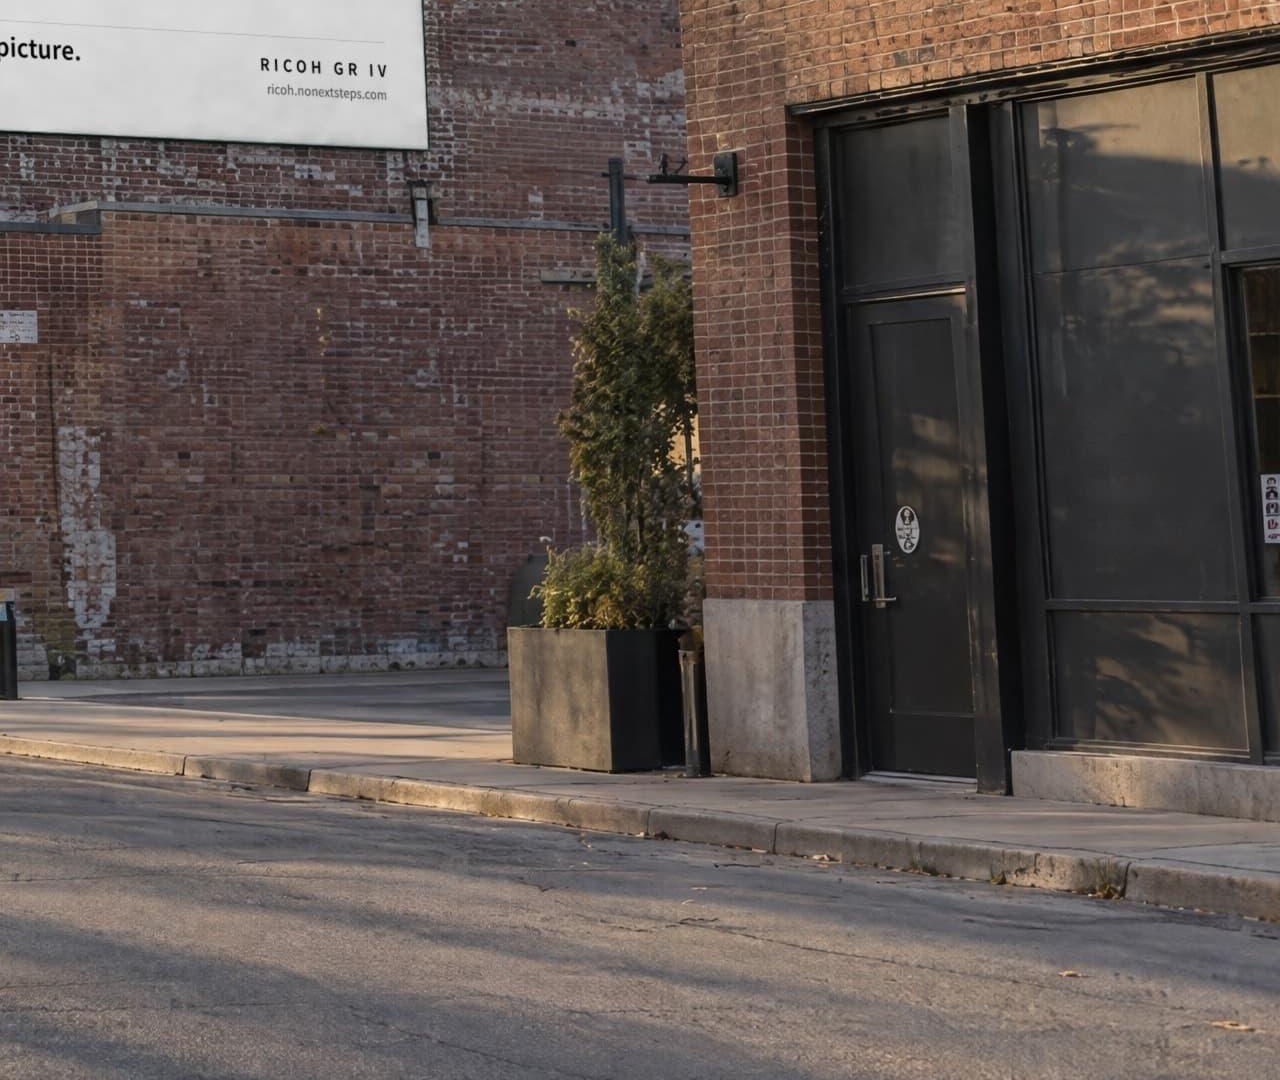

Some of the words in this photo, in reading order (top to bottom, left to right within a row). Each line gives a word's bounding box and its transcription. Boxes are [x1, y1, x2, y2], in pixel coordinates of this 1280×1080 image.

[260, 57, 322, 75] RICOH
[333, 61, 358, 77] GR
[369, 63, 387, 78] IV
[267, 83, 387, 102] ricoh.nonextsteps.com
